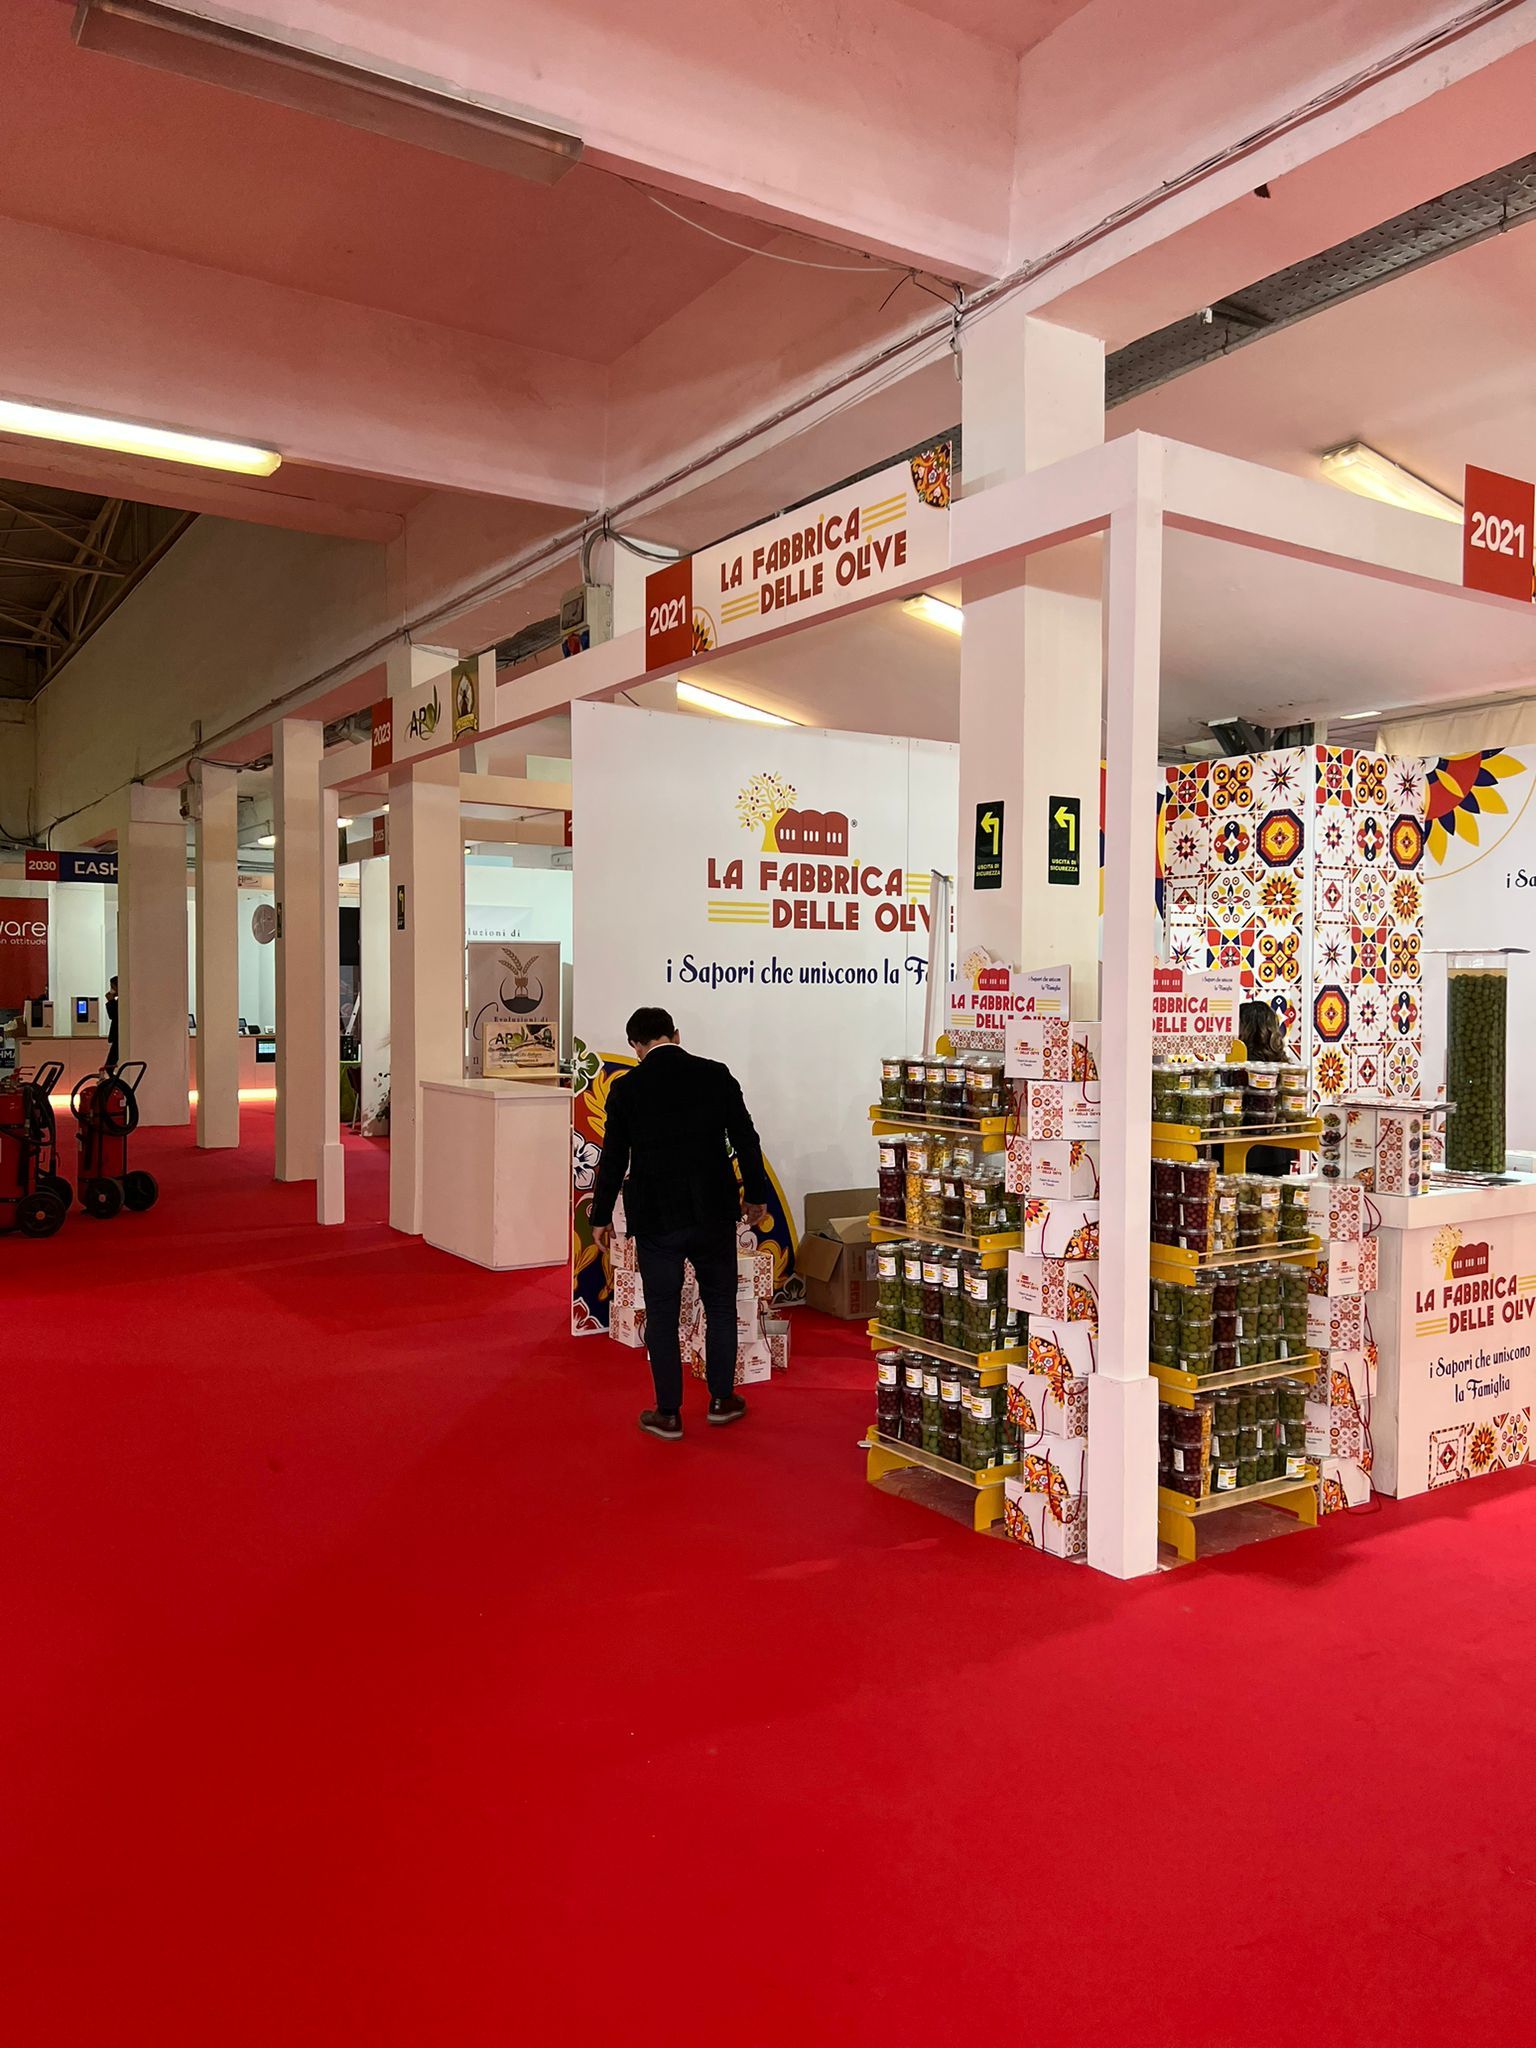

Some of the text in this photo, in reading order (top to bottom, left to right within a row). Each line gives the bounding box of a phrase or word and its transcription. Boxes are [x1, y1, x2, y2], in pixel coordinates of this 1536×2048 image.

[721, 507, 860, 592] LA FABBRICA
[1471, 512, 1524, 558] 2021
[761, 530, 906, 615] DELLE OLIVE
[650, 595, 686, 637] 2021
[374, 722, 390, 746] 2023
[28, 860, 56, 870] 2030
[708, 858, 902, 896] LA FABBRICA
[1506, 873, 1510, 888] i
[772, 897, 932, 932] DELLE OLIV
[510, 929, 520, 938] di
[666, 958, 672, 982] i
[680, 954, 754, 989] Sapori
[761, 956, 793, 984] che
[799, 961, 878, 984] uniscono
[884, 958, 900, 984] la
[952, 993, 1035, 1012] LA FABBRICA
[1153, 993, 1208, 1013] ABBRICA
[1194, 1014, 1232, 1033] OLIVE
[1416, 1274, 1517, 1314] LA FABBRICA
[1449, 1305, 1494, 1334] DELLE
[1430, 1345, 1530, 1378] i Sapori che uniscono
[1455, 1374, 1510, 1403] la Famiglia
